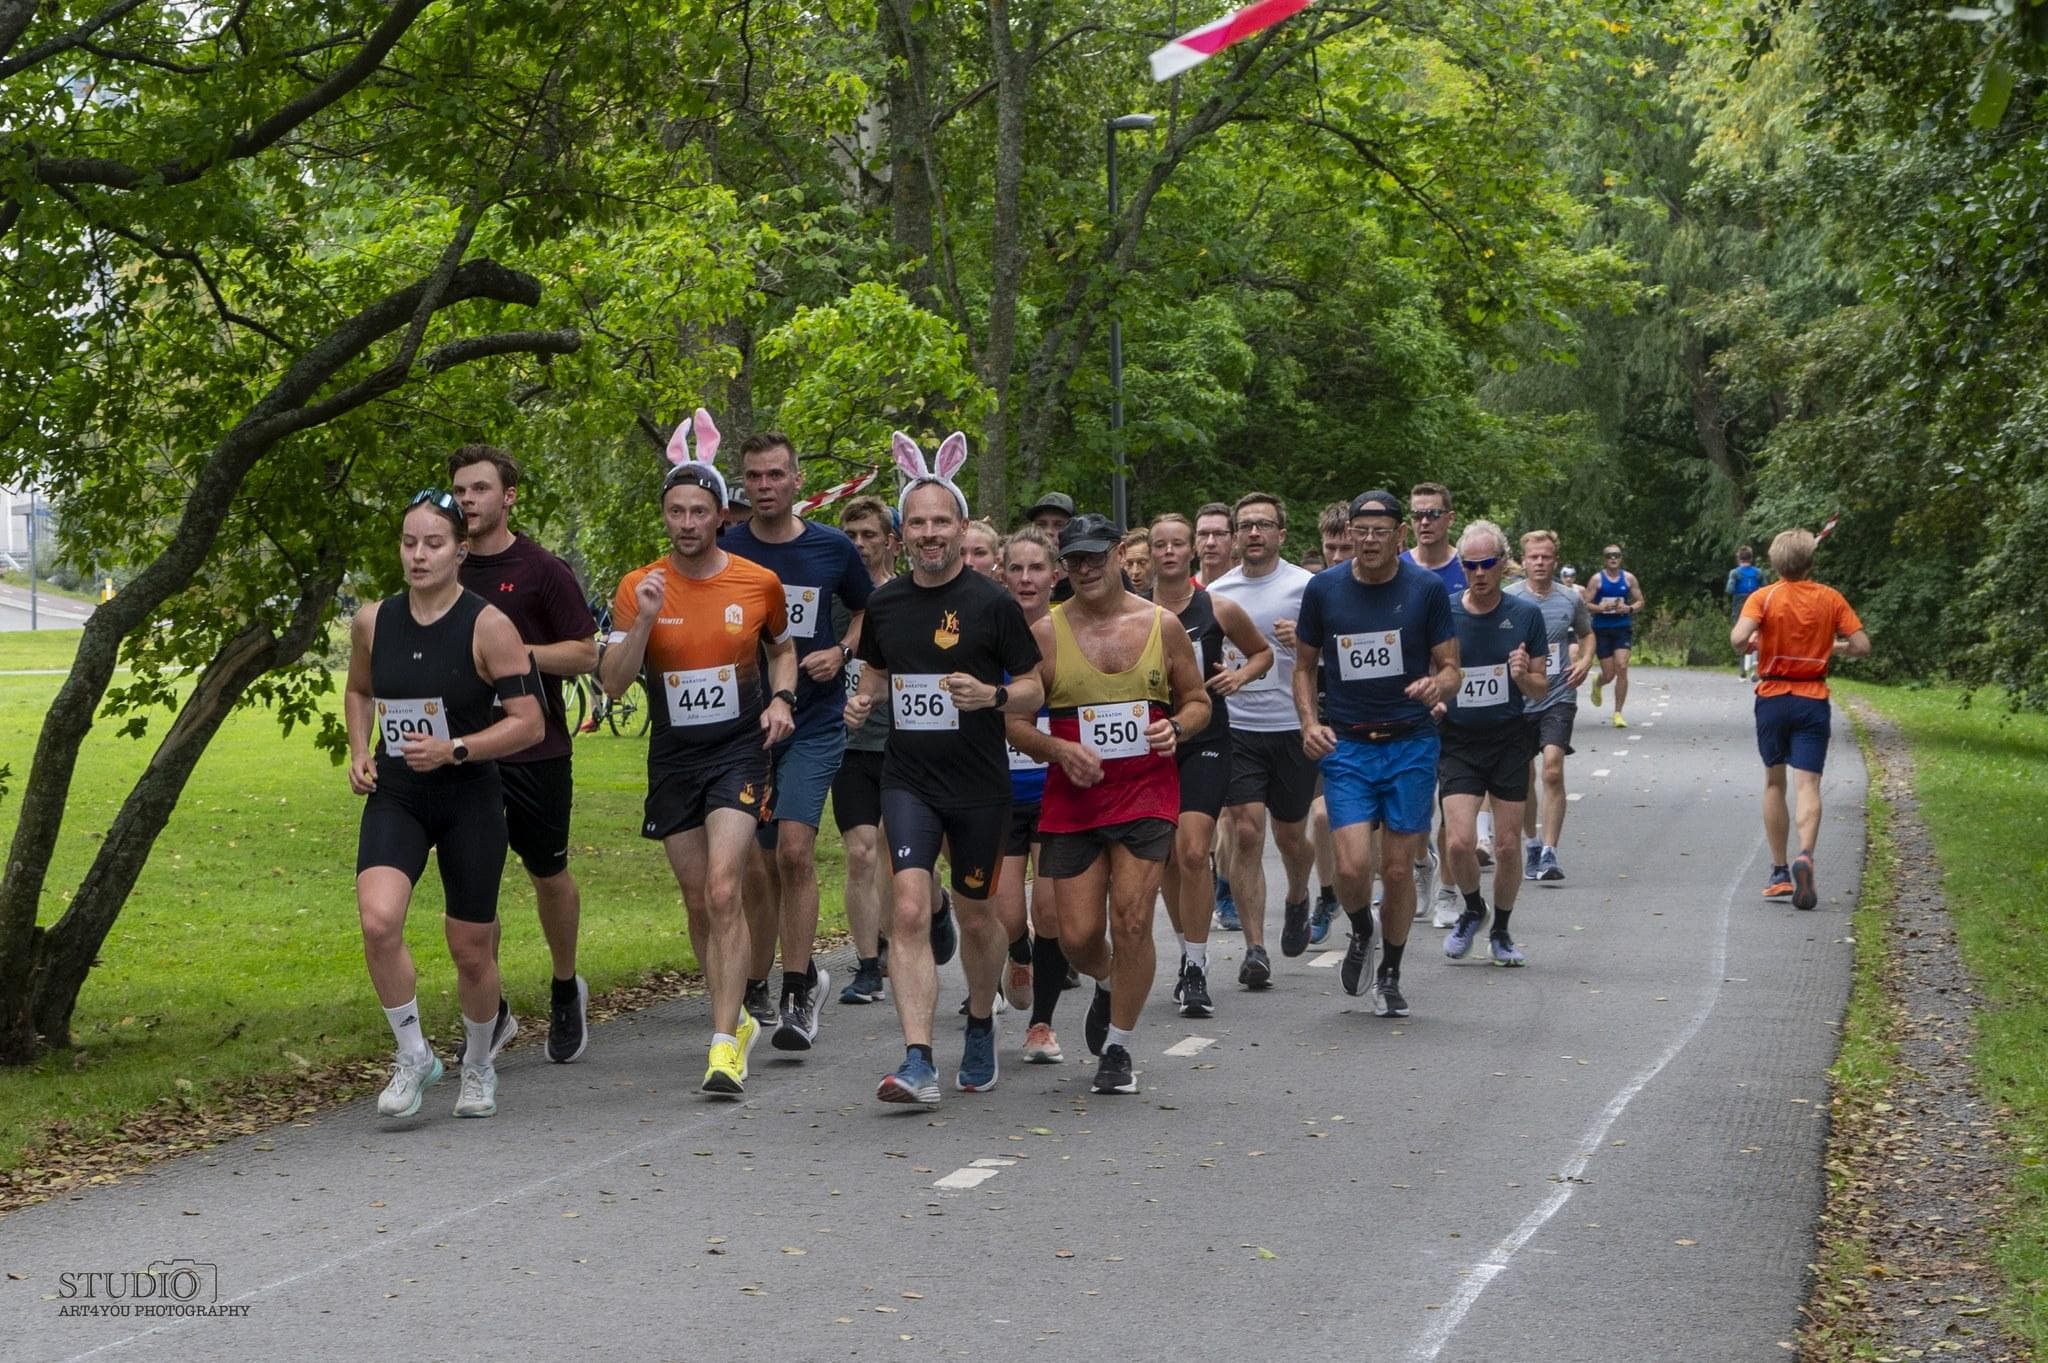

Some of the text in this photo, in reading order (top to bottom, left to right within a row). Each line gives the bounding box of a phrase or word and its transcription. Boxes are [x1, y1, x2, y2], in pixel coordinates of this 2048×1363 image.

[785, 603, 804, 624] 8
[1350, 647, 1391, 669] 648
[678, 685, 726, 711] 442
[1464, 678, 1499, 697] 470
[901, 693, 944, 717] 356
[386, 718, 434, 743] 590
[1093, 720, 1138, 746] 550
